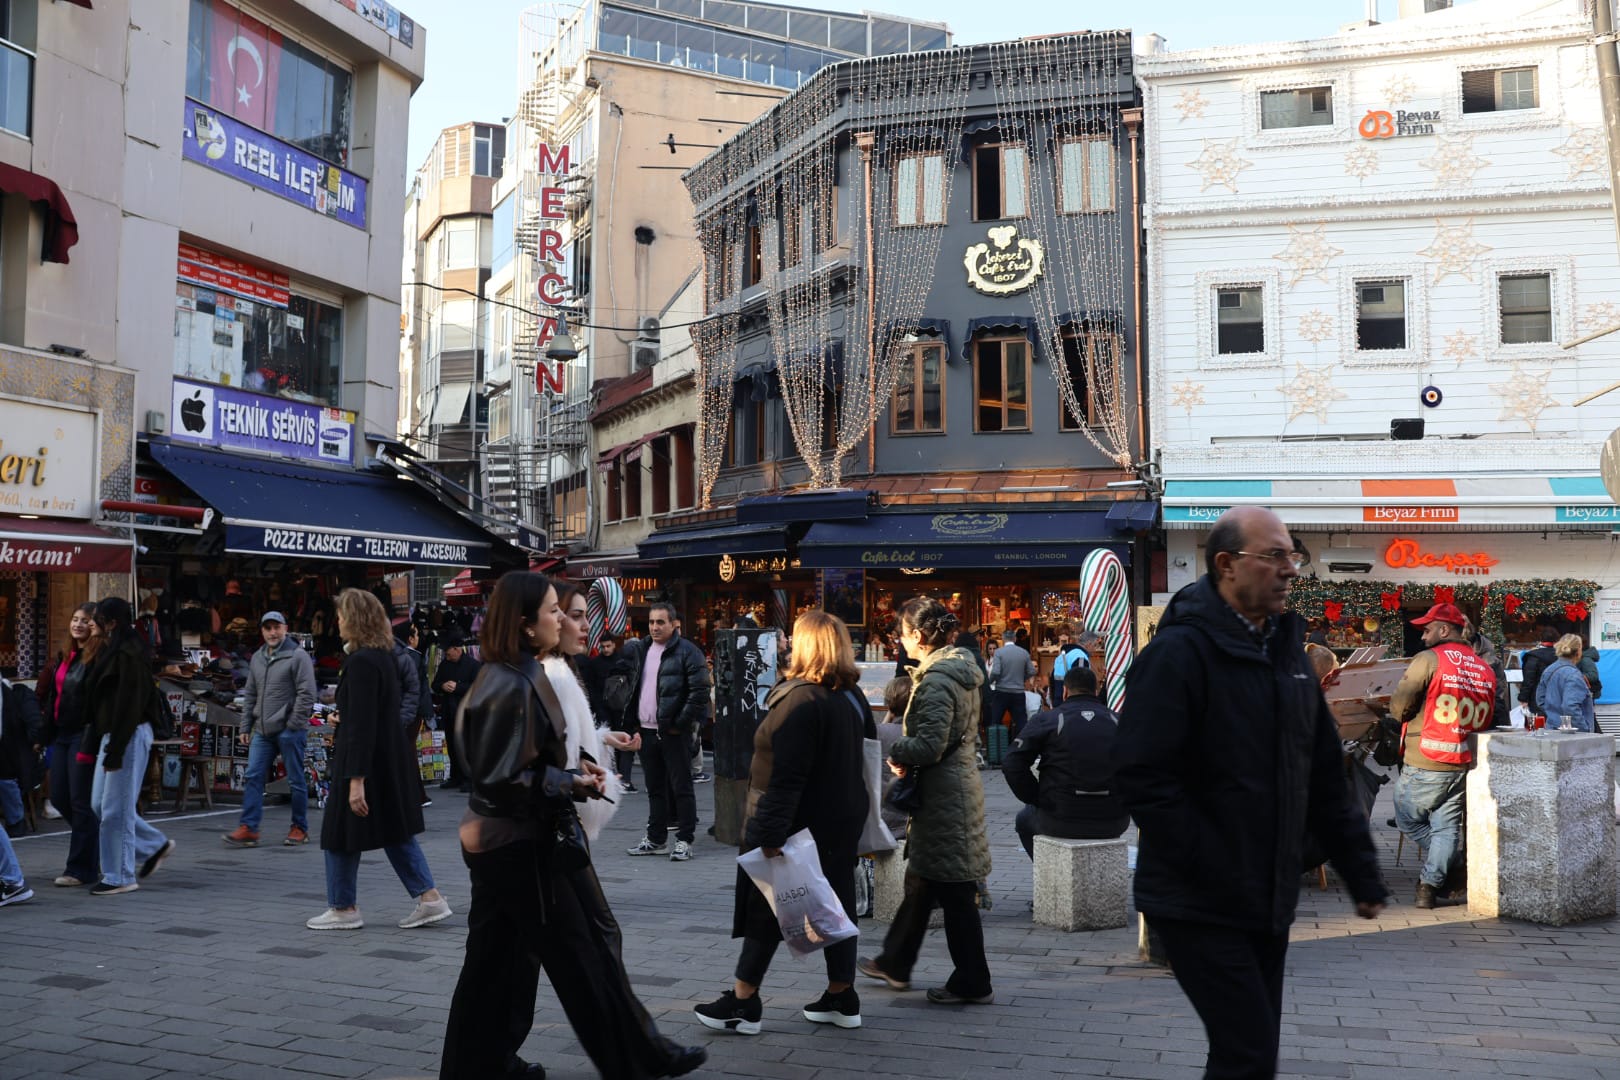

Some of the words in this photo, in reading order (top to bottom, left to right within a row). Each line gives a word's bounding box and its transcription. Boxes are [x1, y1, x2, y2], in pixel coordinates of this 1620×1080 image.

[1396, 110, 1441, 123] Beyaz
[234, 137, 280, 181] REEL
[285, 153, 355, 213] İLETİM
[535, 142, 570, 395] MERCAN
[994, 273, 1016, 283] 1807
[218, 400, 269, 438] TEKNİK
[272, 408, 316, 446] SERVİS
[0, 440, 49, 488] eri
[1375, 506, 1417, 521] Beyaz
[1566, 506, 1609, 521] Beyaz
[263, 529, 305, 550] POZZE
[306, 533, 351, 554] KASKET
[420, 542, 468, 562] AKSESUAR
[861, 551, 890, 564] Cafer
[890, 550, 916, 562] Erol
[921, 553, 944, 561] 1807
[1035, 552, 1068, 560] LONDON
[1385, 537, 1501, 572] Beyaz
[1454, 567, 1490, 575] FIRIN
[1433, 693, 1490, 729] 800
